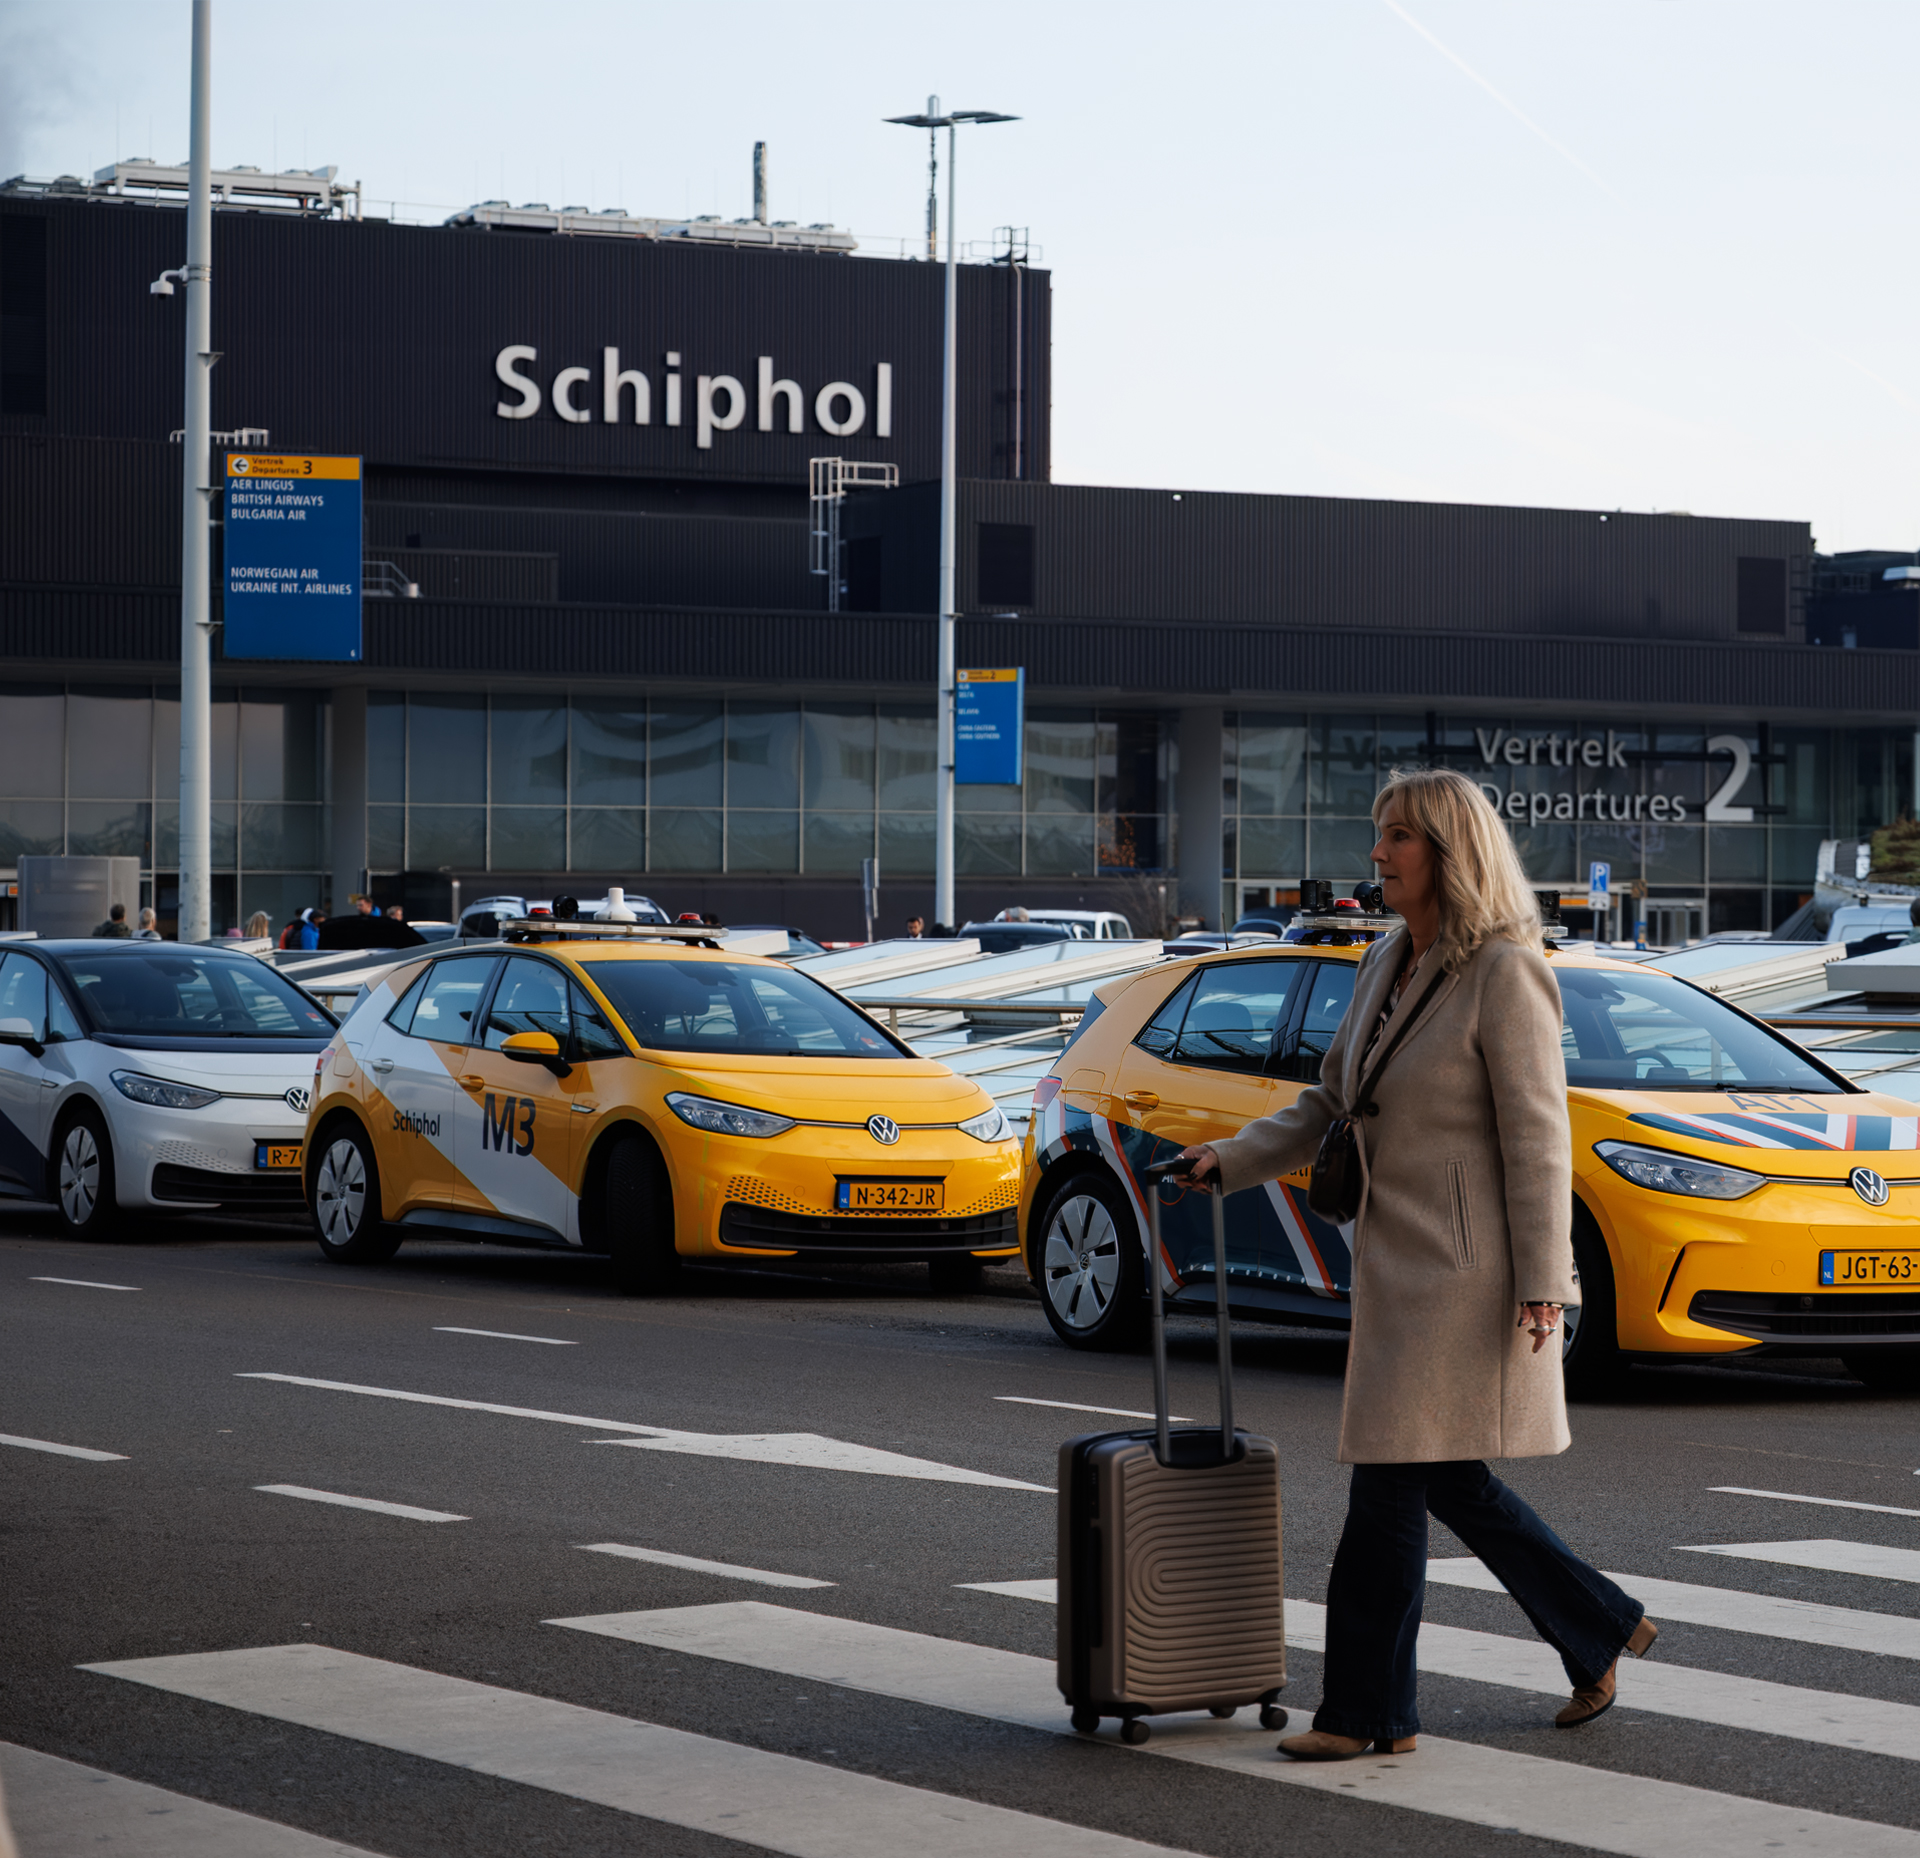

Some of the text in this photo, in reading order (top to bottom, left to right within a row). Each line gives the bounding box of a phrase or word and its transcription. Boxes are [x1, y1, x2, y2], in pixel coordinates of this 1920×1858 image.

[495, 344, 892, 449] Schiphol
[252, 457, 284, 465] Vertrek
[252, 460, 313, 475] Departures 3
[231, 479, 295, 491] AER LINGUS
[231, 493, 324, 506] BRITISH AIRWAYS
[231, 508, 306, 521] BULGARIA AIR
[231, 567, 319, 580] NORWEGIAN AIR
[231, 582, 352, 595] UKRAINE INT. AIRLINES
[990, 670, 996, 680] 2
[1475, 727, 1627, 768] Vertrek
[1704, 734, 1754, 822] 2
[393, 1110, 441, 1139] Schiphol
[482, 1092, 536, 1157] M3
[857, 1187, 935, 1205] N-342-JR
[1824, 1271, 1833, 1279] NL
